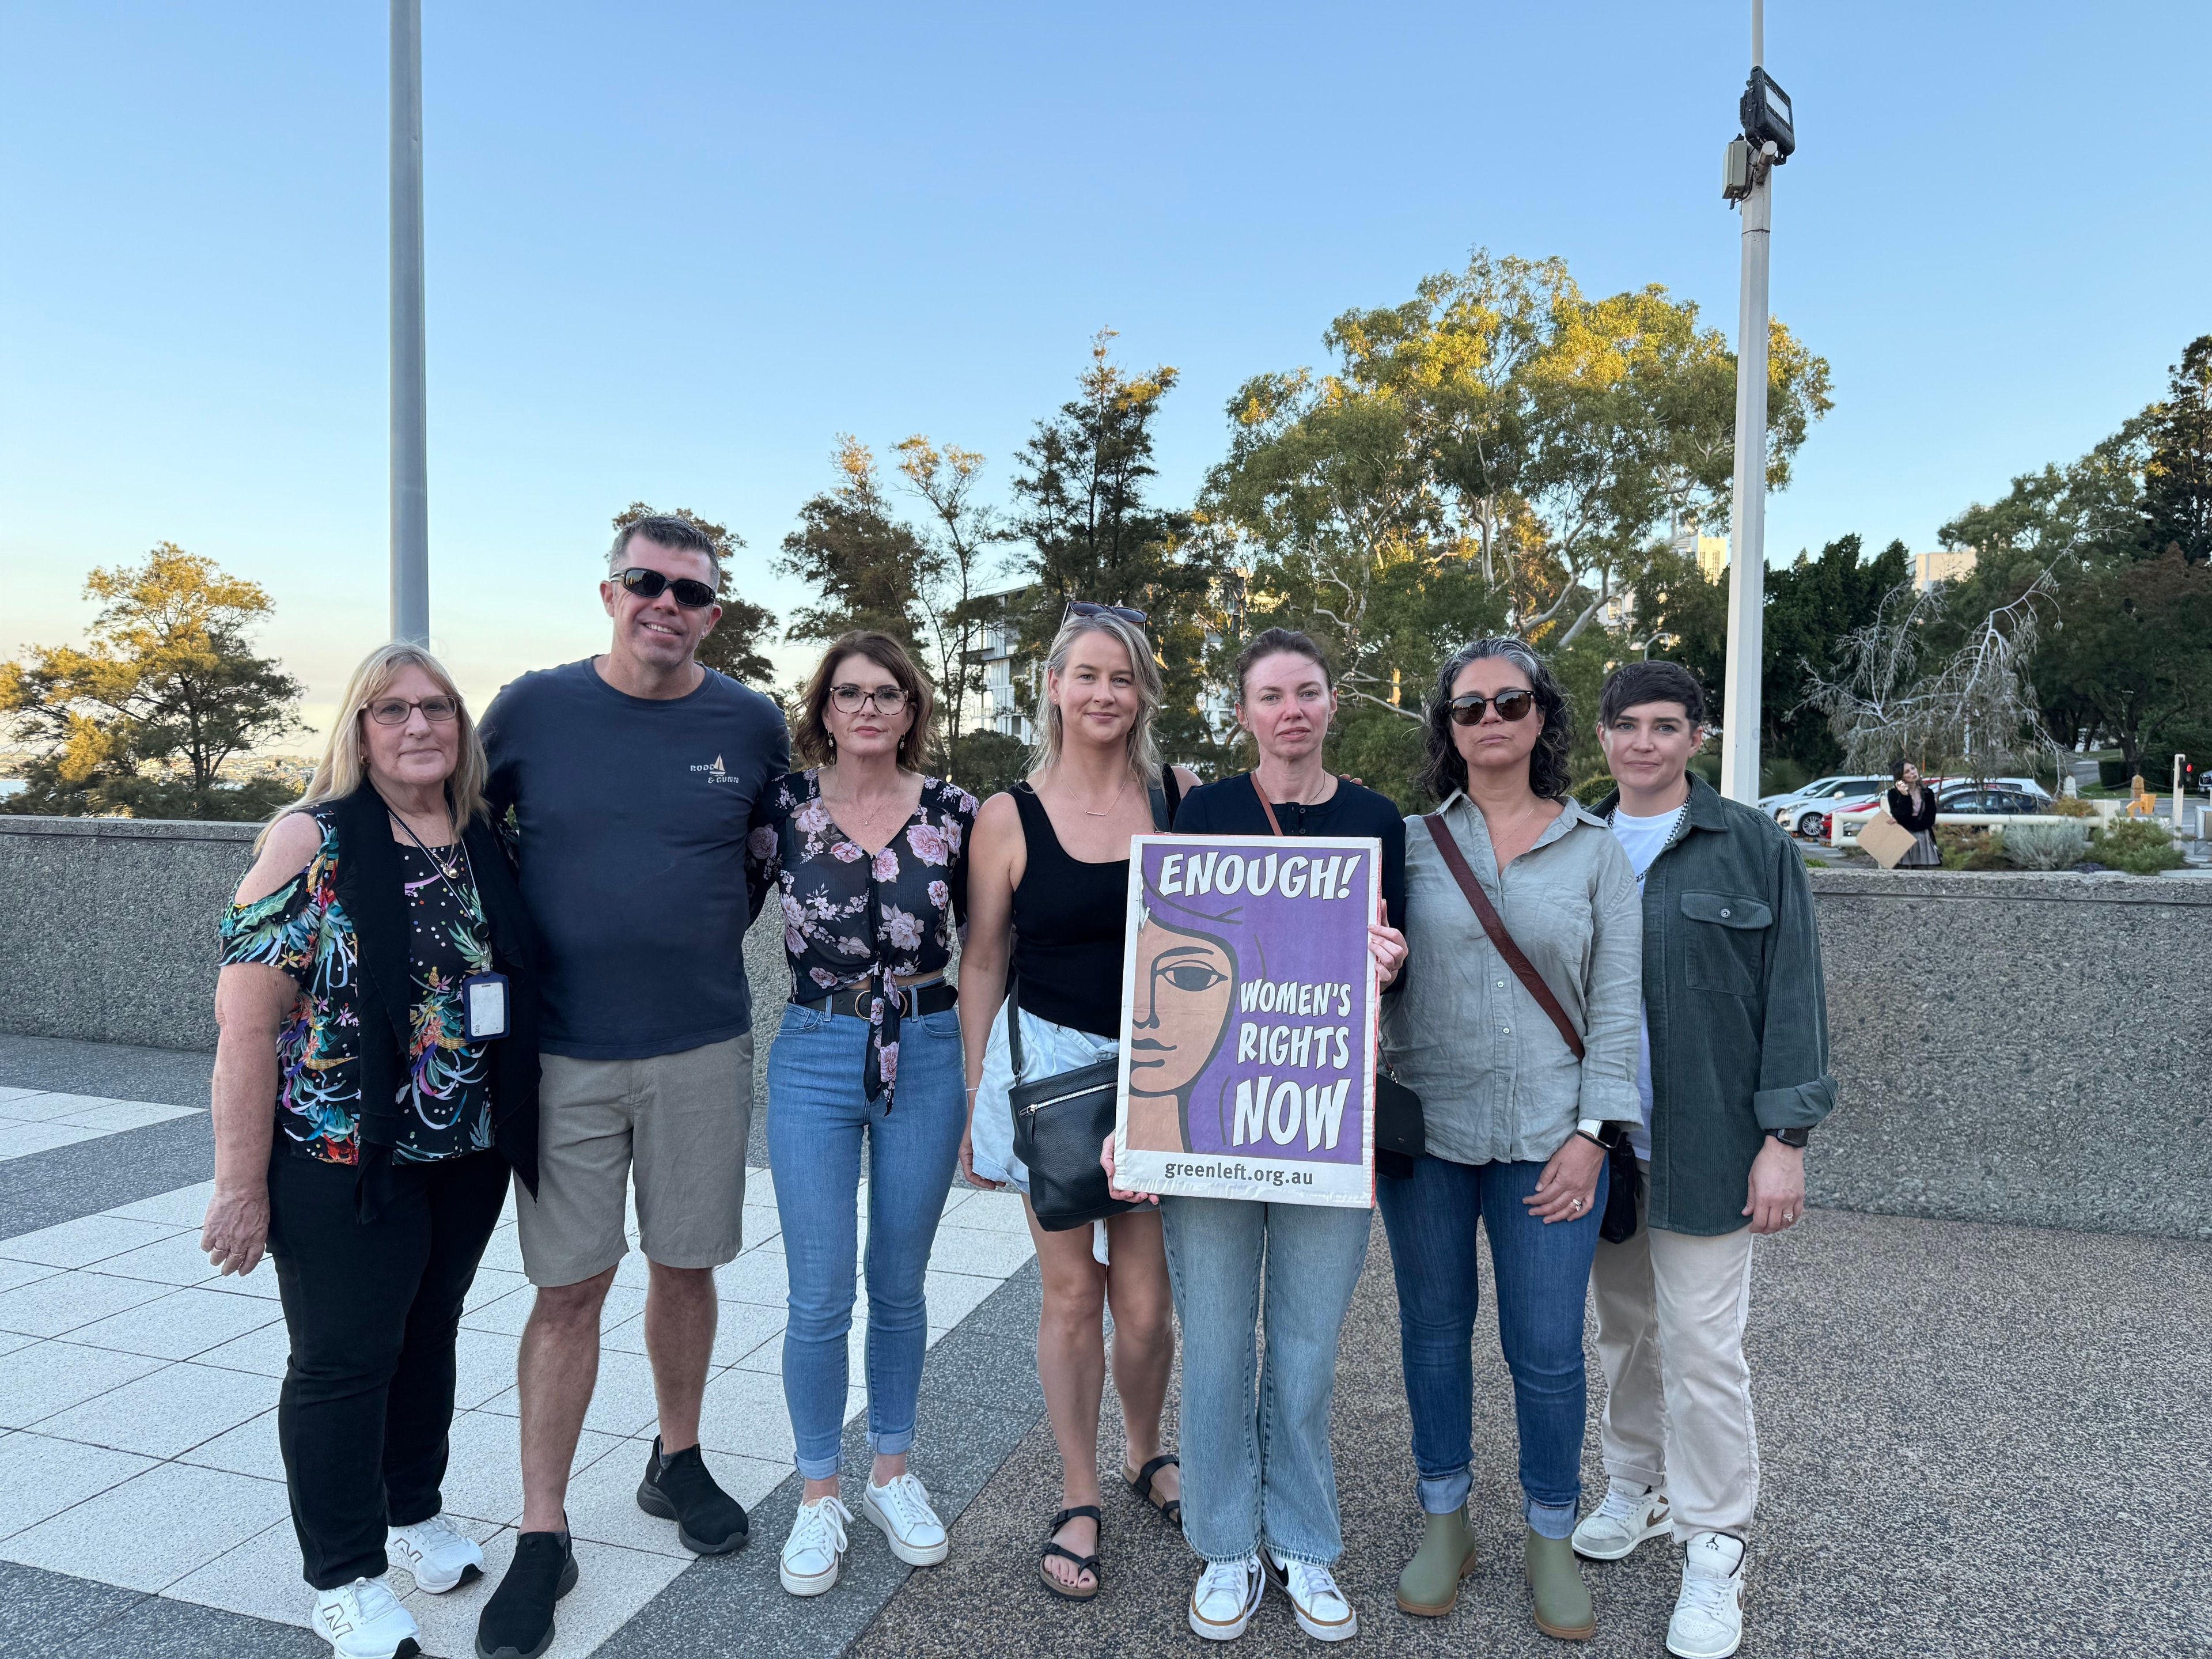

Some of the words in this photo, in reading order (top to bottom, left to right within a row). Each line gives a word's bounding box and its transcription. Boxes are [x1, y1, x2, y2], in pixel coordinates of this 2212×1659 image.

[1158, 850, 1363, 900] ENOUGH!
[1240, 979, 1351, 1017] WOMEN'S
[1237, 1022, 1350, 1070] RIGHTS
[1232, 1075, 1353, 1153] NOW
[1164, 1161, 1314, 1187] greenleft.org.au
